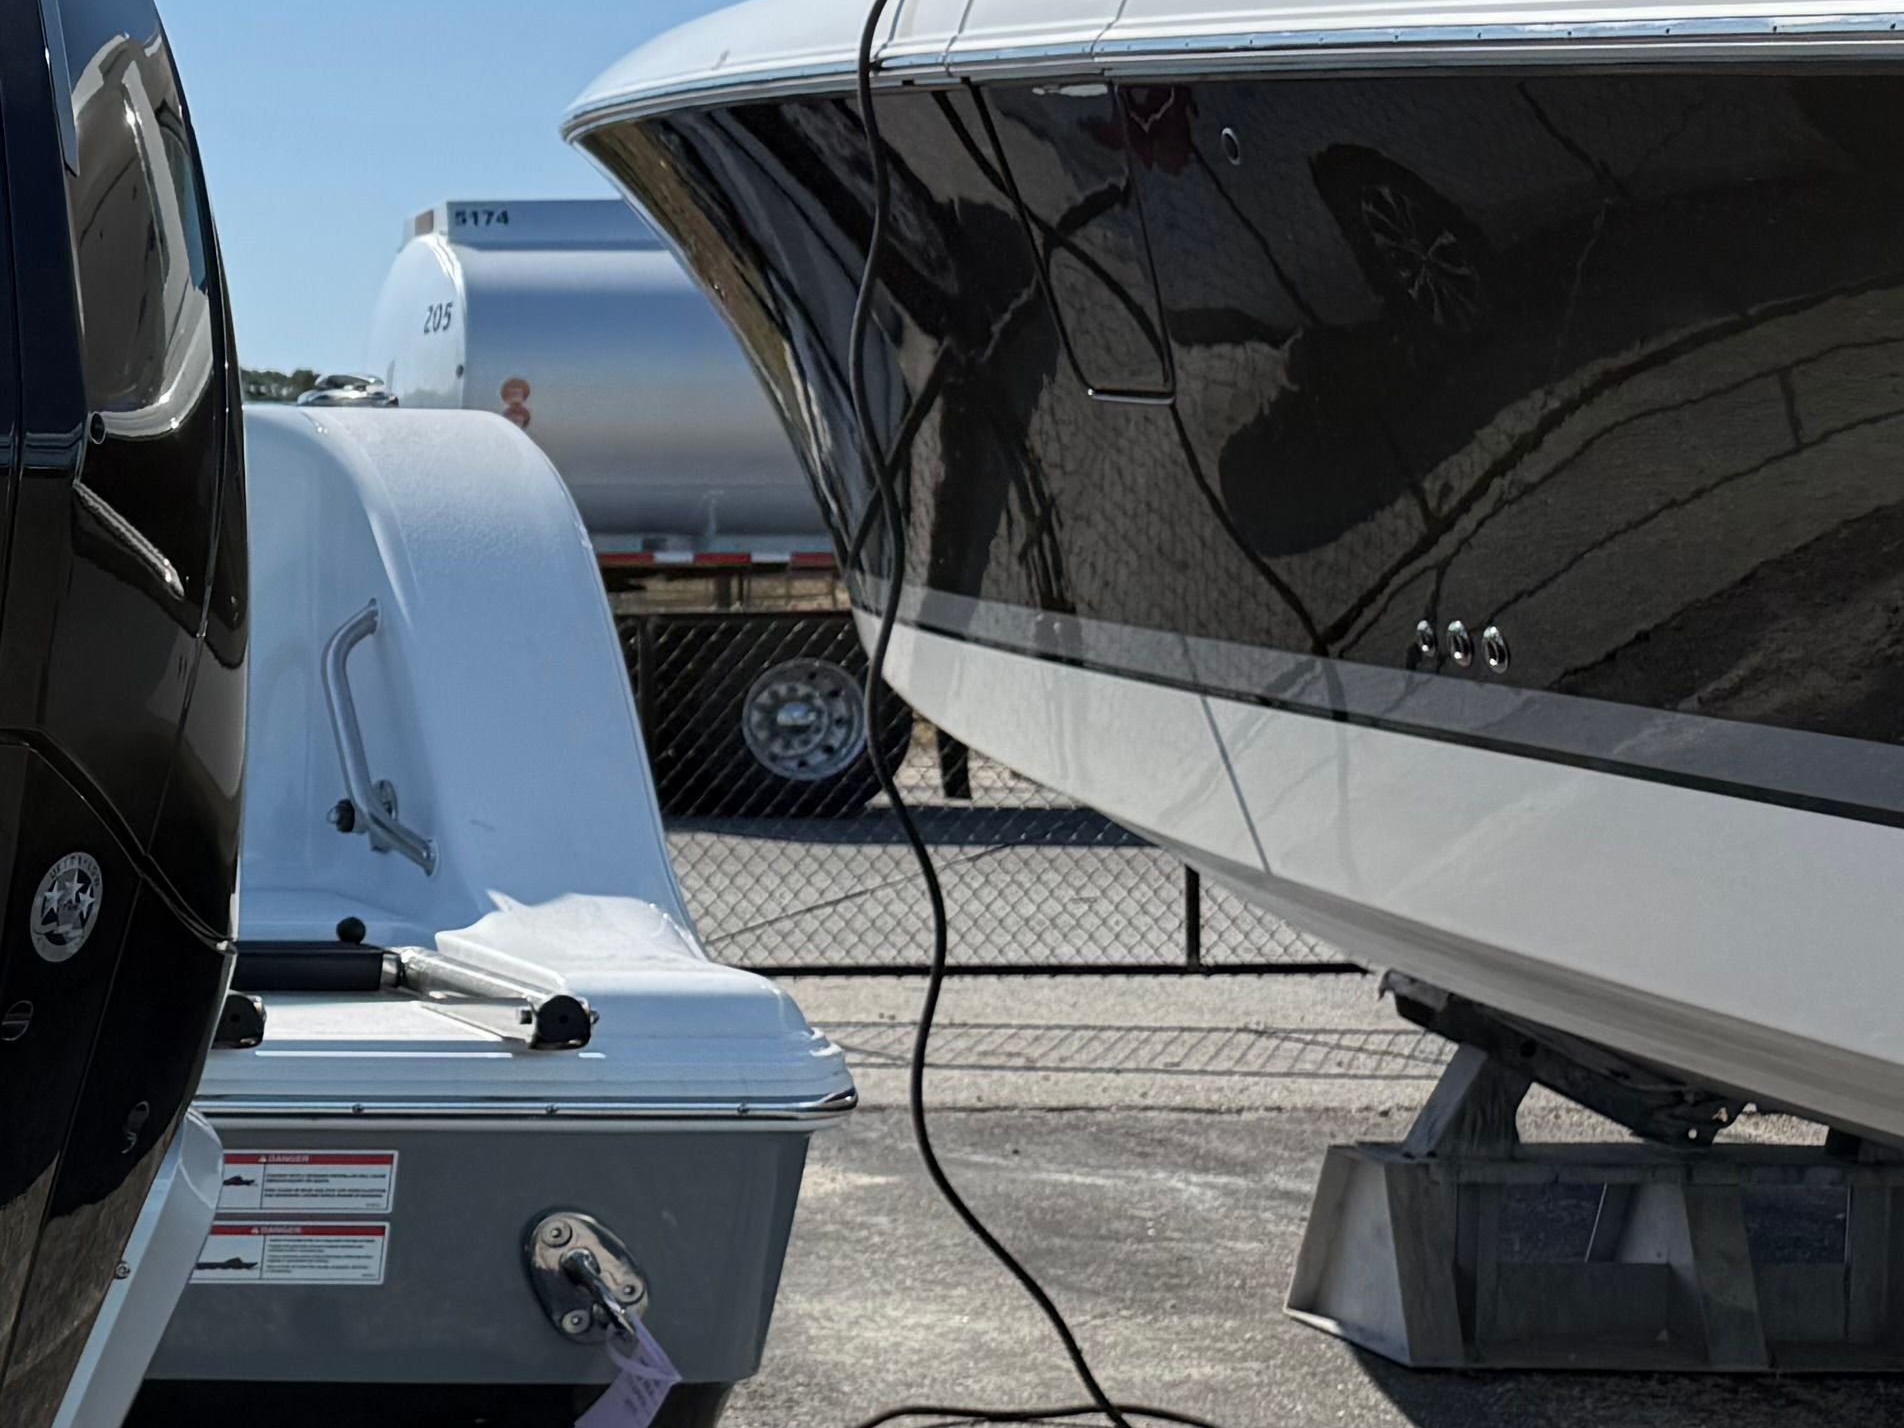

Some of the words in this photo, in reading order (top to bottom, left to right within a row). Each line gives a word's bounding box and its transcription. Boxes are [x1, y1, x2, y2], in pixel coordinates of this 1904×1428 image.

[454, 209, 510, 227] 5174
[423, 301, 453, 335] 205
[268, 1154, 309, 1163] DANGER
[260, 1226, 302, 1234] DANGER
